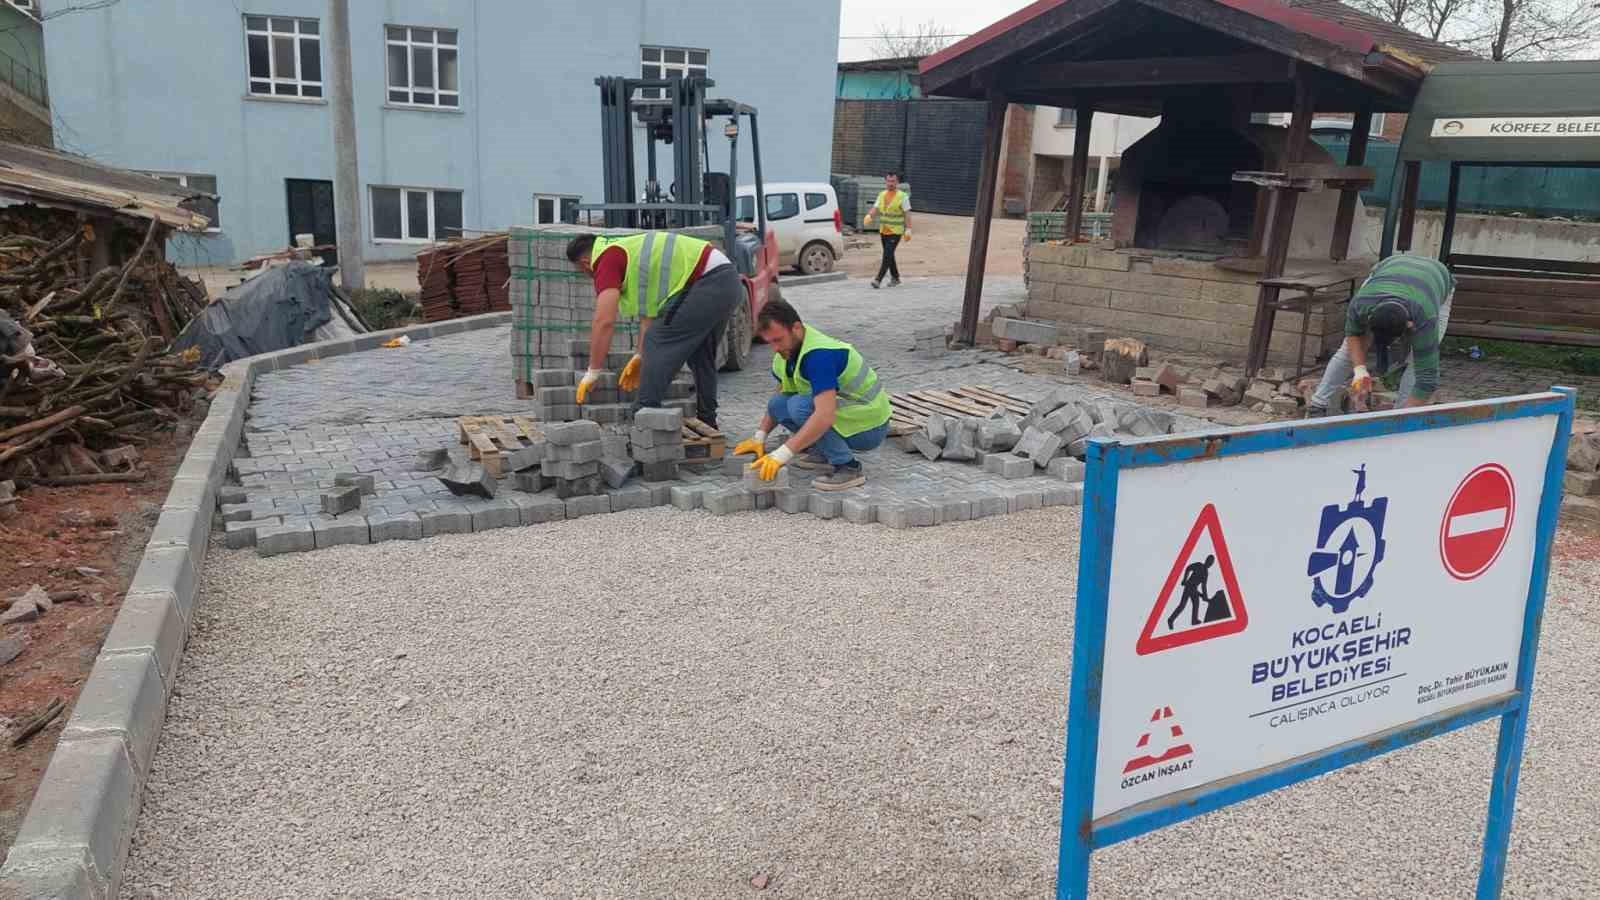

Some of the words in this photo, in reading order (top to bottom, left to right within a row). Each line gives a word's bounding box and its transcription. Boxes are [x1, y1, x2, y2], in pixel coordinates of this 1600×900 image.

[1490, 121, 1552, 133] KÖRFEZ
[1292, 612, 1381, 648] KOCAELİ
[1251, 627, 1411, 684] BÜYÜKŞEHİR
[1272, 656, 1391, 702] BELEDİYESİ
[1340, 685, 1390, 708] OLUYOR
